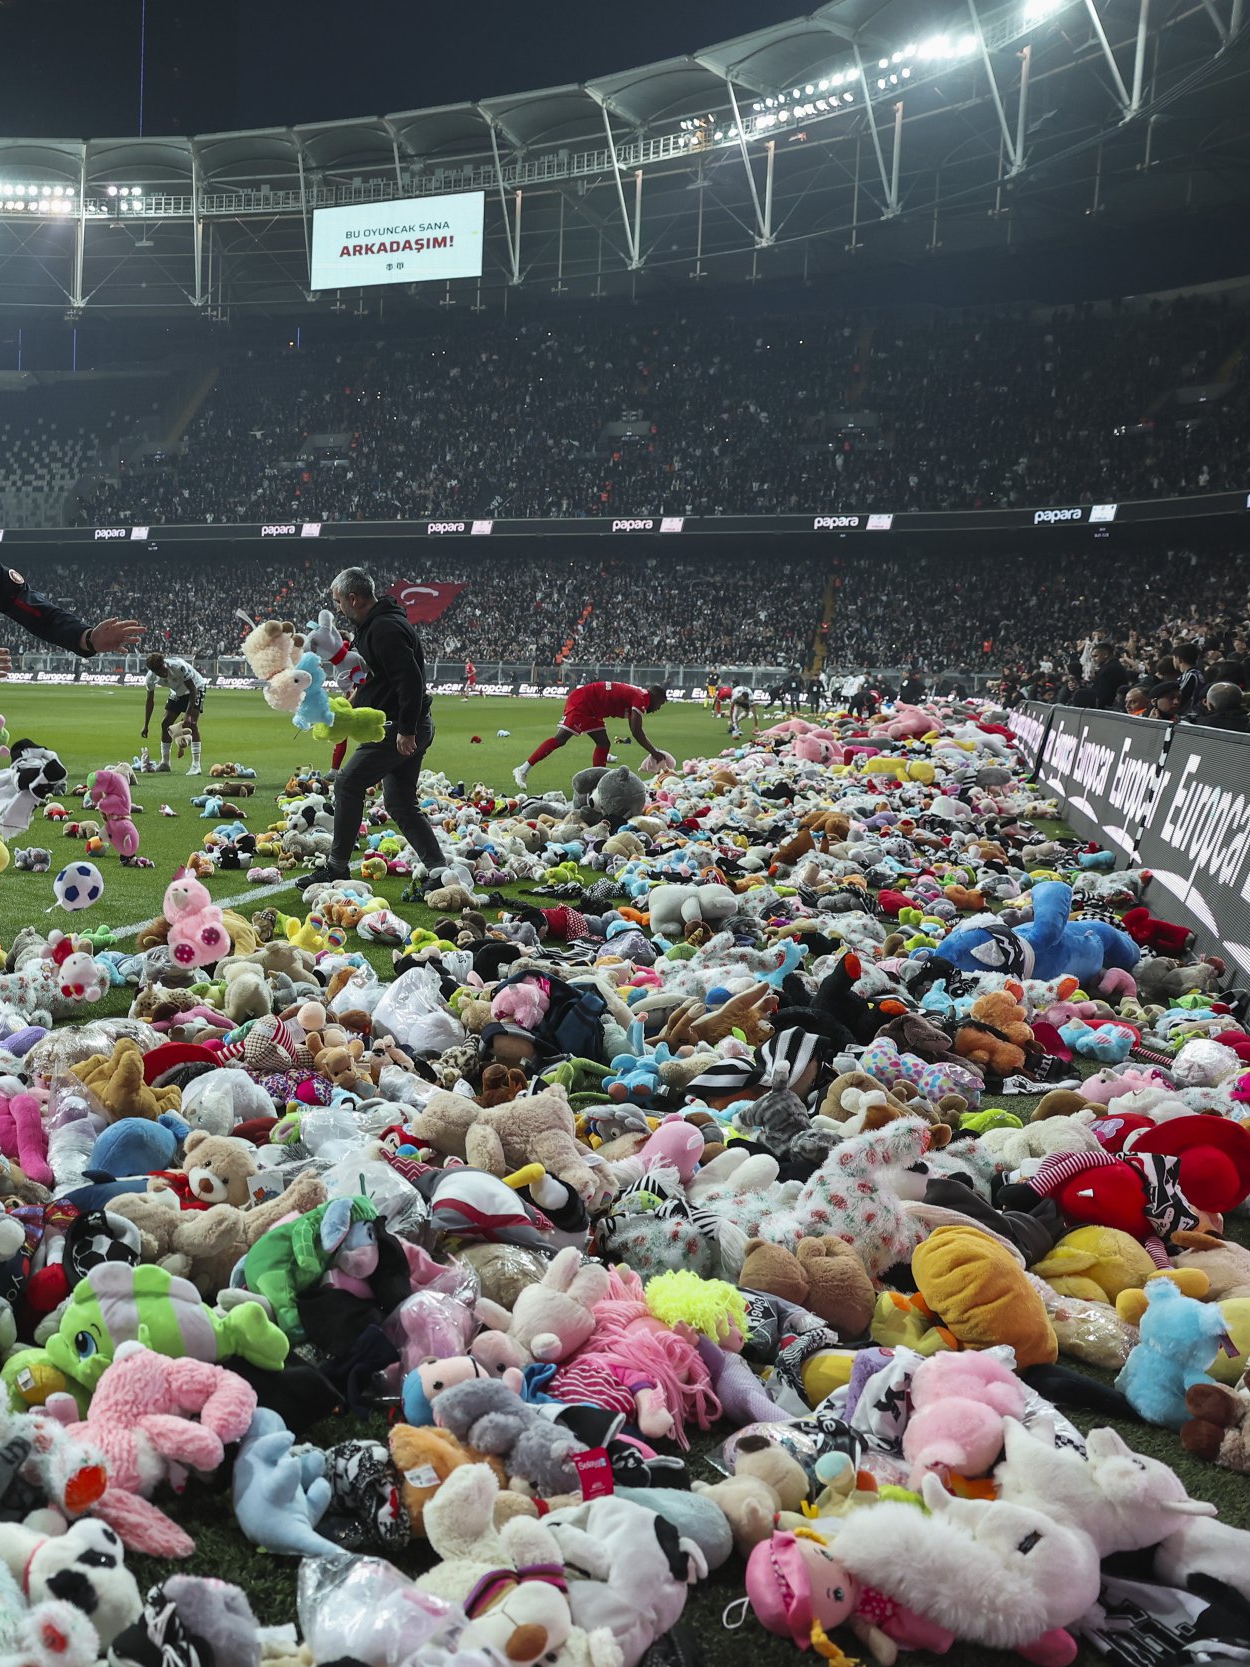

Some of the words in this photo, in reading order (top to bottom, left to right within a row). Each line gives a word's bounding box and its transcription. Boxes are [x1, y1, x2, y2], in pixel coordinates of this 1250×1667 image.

[345, 230, 361, 239] BU
[363, 225, 416, 238] OYUNCAK
[419, 221, 450, 232] SANA
[339, 235, 454, 257] ARKADAŞIM!
[813, 516, 859, 530] papara
[1033, 508, 1082, 525] papara
[261, 525, 296, 537] papara
[427, 522, 465, 535] papara
[612, 519, 653, 532] papara
[94, 528, 126, 540] papara
[37, 672, 76, 682] Europcar
[80, 672, 121, 683] Europcar
[1072, 726, 1115, 811] Europcar
[750, 1297, 766, 1326] 1903
